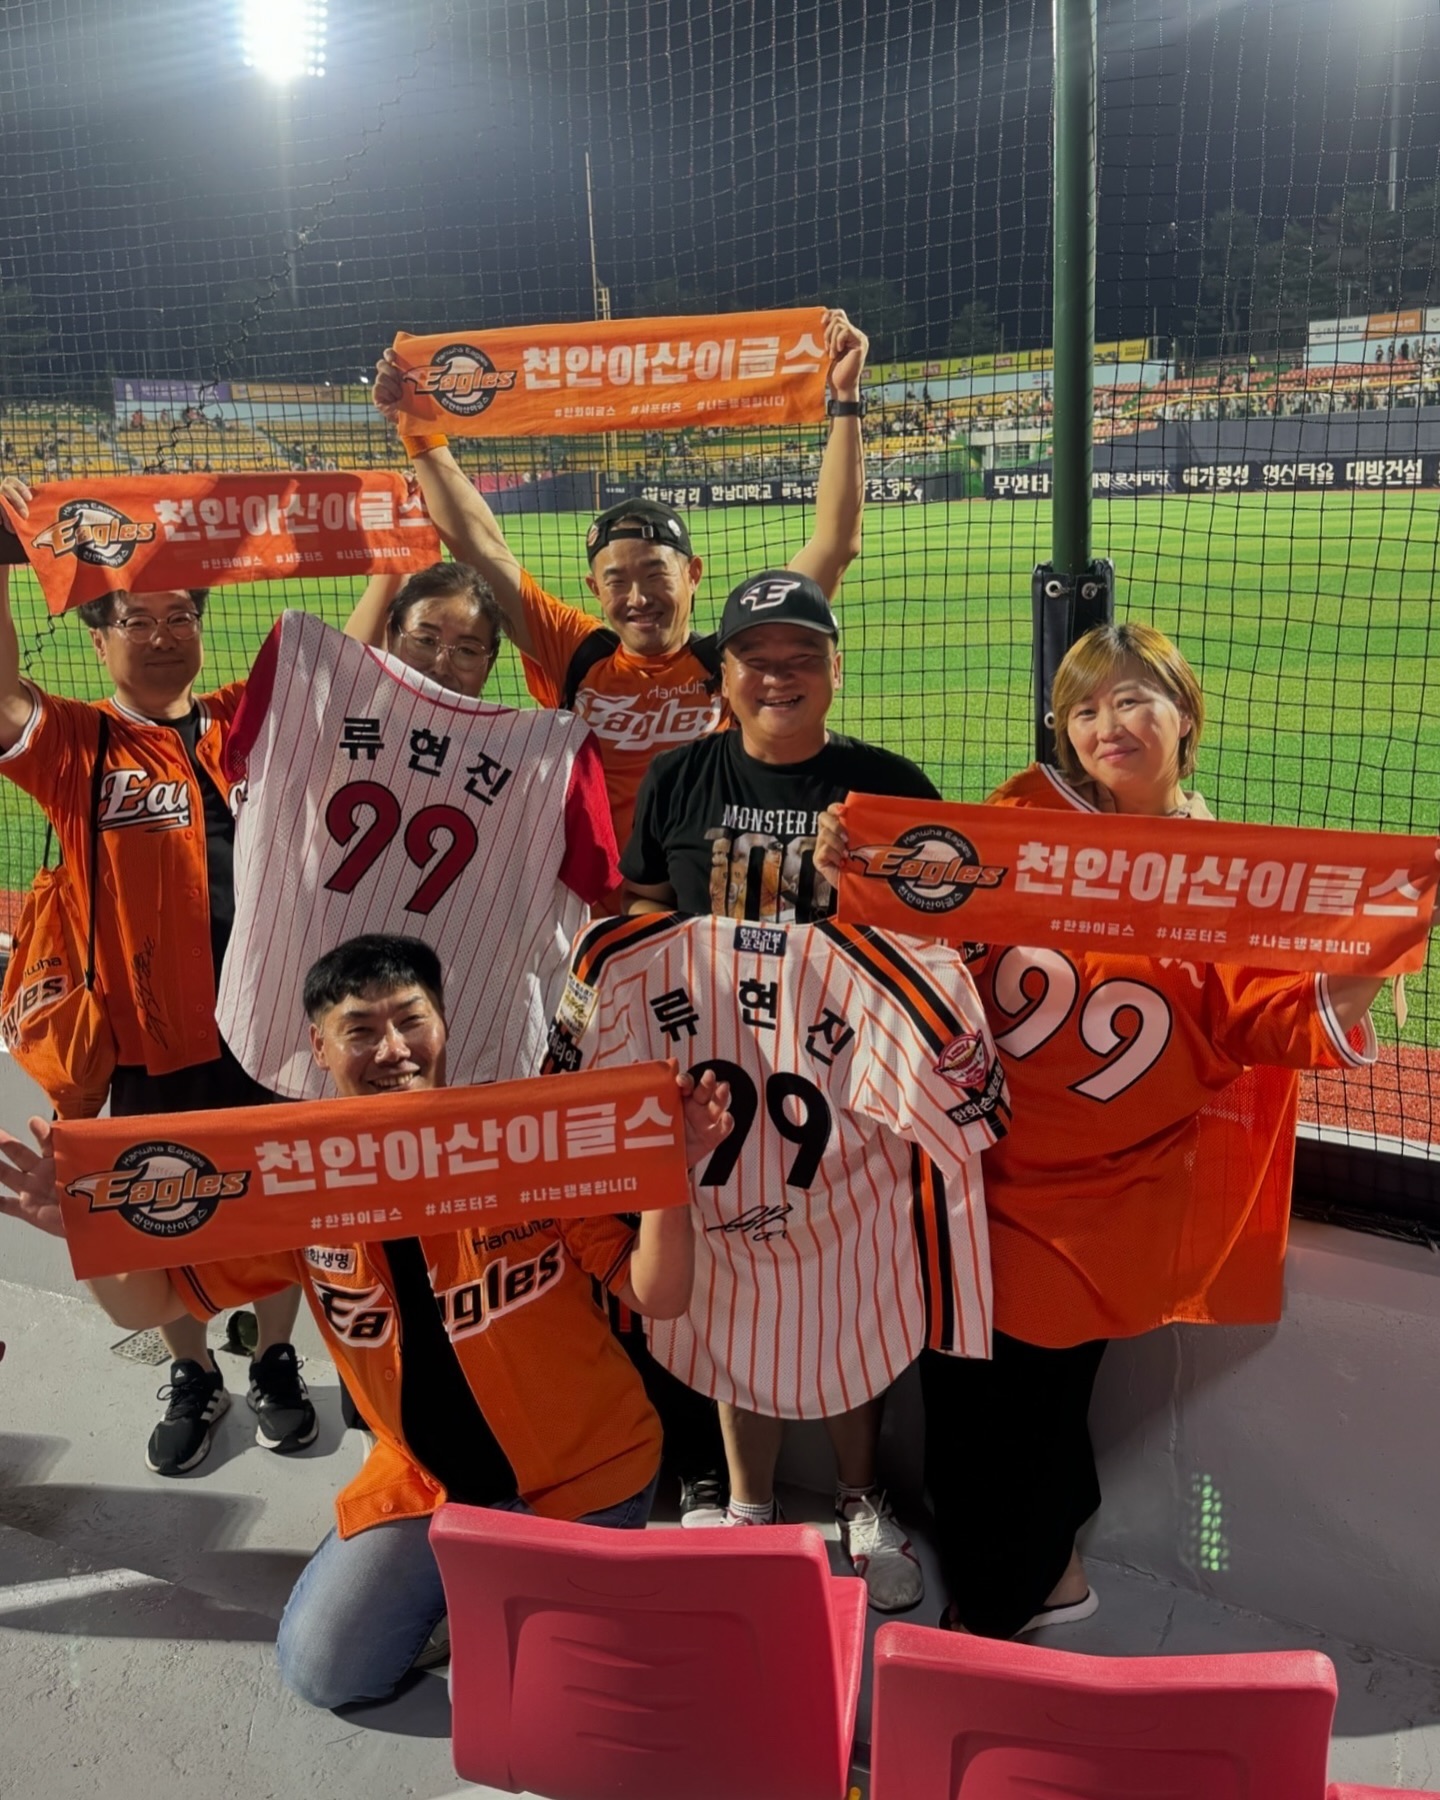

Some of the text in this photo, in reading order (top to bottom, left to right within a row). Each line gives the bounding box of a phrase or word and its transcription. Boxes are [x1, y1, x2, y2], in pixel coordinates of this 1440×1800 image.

[404, 361, 517, 397] Eagles
[523, 332, 826, 391] 천안아산이글스
[1346, 458, 1422, 485] 대방건설
[32, 511, 157, 558] Eagles
[153, 490, 434, 542] 천안아산이글스
[647, 682, 707, 699] Hanwh
[339, 717, 513, 807] 류현진
[721, 804, 808, 835] MONSTER
[323, 780, 479, 916] 99
[851, 844, 1009, 889] Eagles
[1015, 840, 1422, 919] 천안아산이글스
[1049, 919, 1372, 956] #한화이글스 #서포터즈 #나는행복합니다
[650, 977, 855, 1067] 류현진
[989, 945, 1173, 1104] 99
[256, 1095, 676, 1197] 천안아산이글스
[686, 1058, 832, 1190] 99
[167, 1145, 205, 1168] Eagles
[65, 1161, 251, 1213] Eagles
[310, 1176, 638, 1230] #한화이글스 #서포터즈 #나는행복합니다
